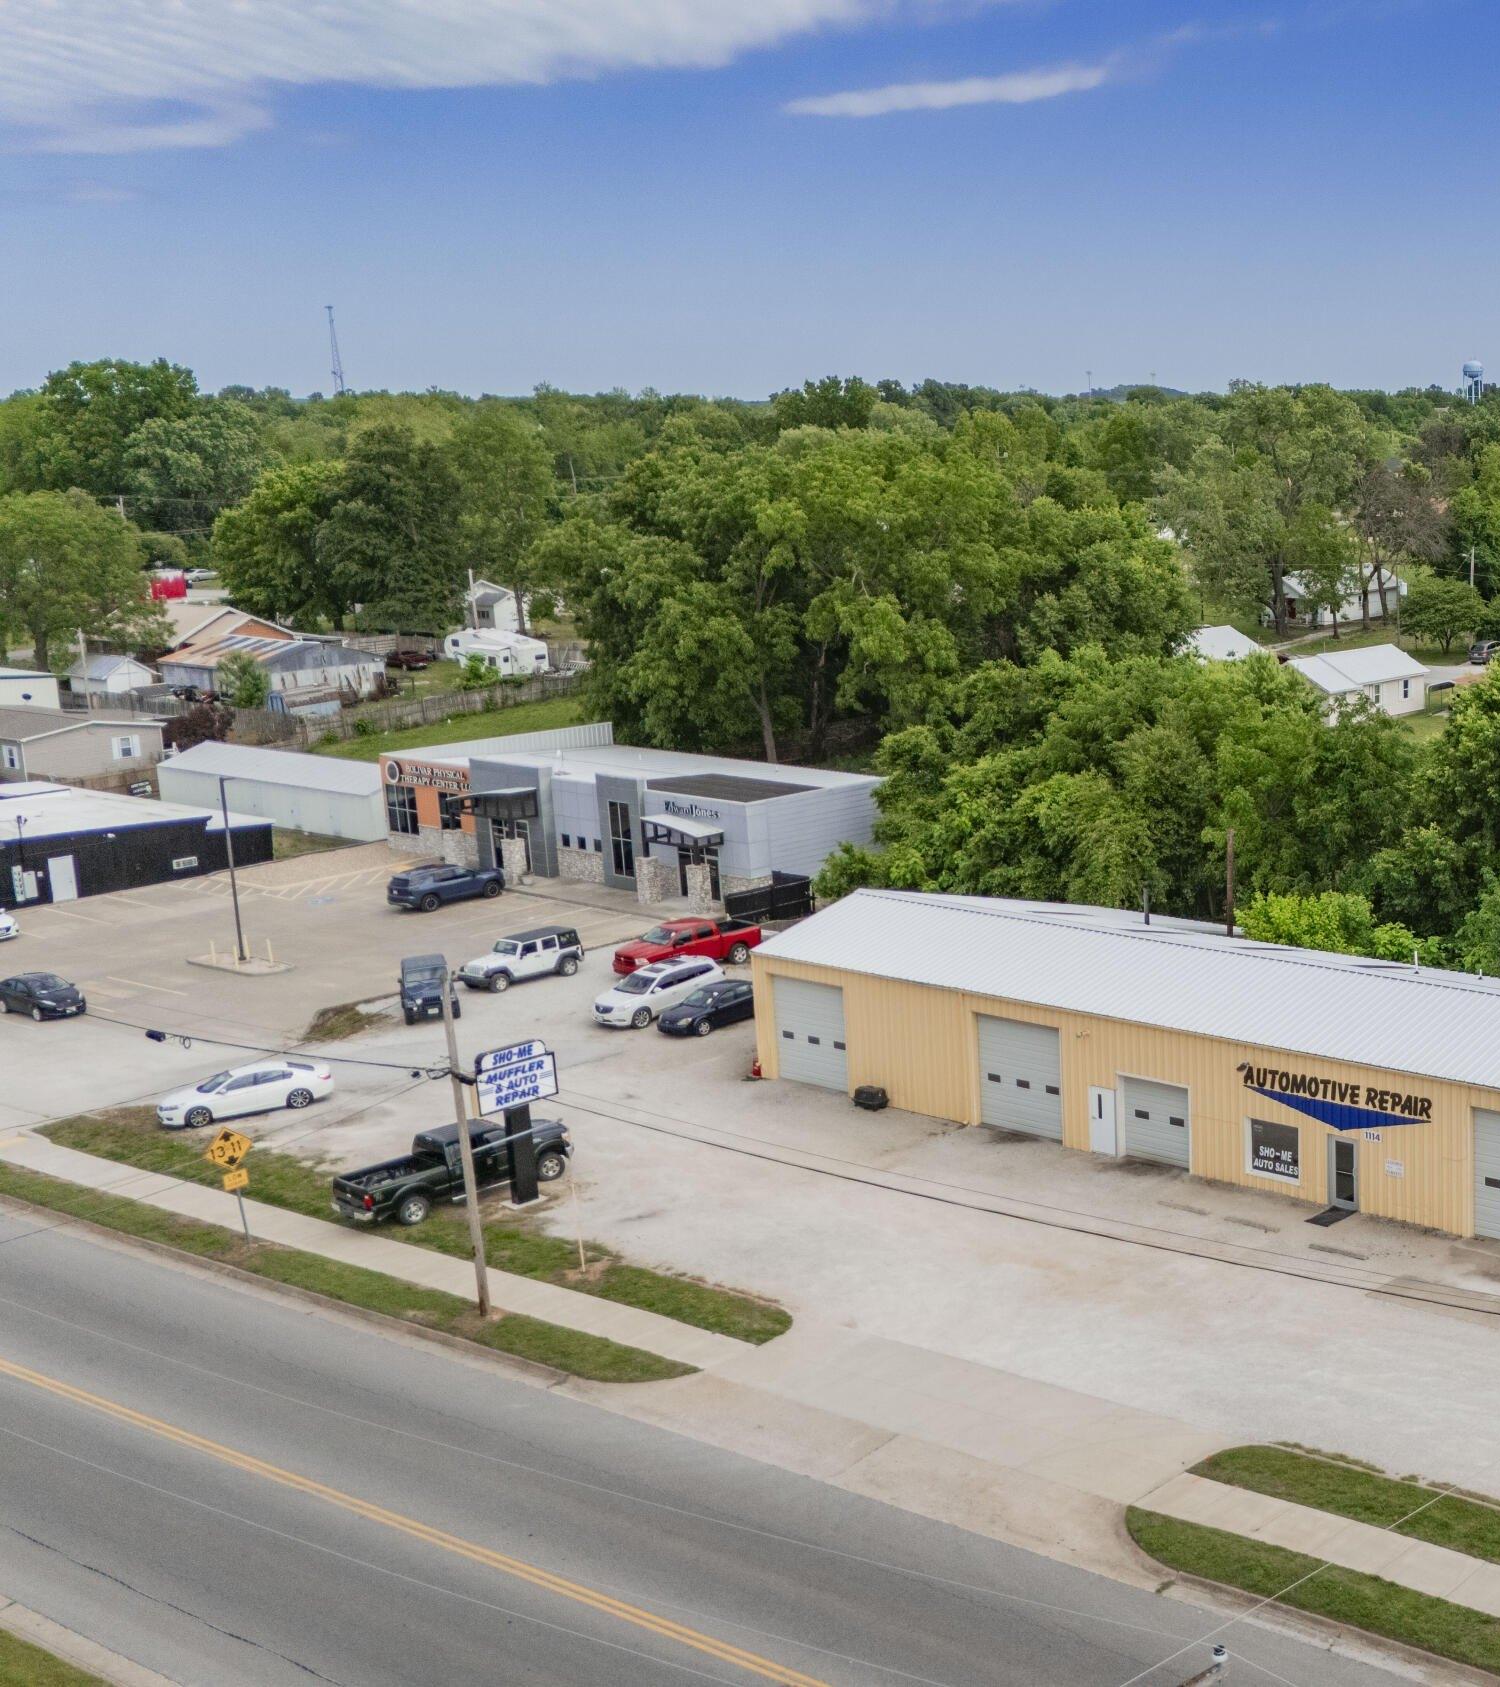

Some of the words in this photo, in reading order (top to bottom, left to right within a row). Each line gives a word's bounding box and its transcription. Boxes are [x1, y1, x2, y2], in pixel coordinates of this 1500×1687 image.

[400, 774, 431, 787] THERAPY
[405, 764, 432, 776] BOLIVAR
[433, 768, 465, 780] PHYSICAL
[692, 804, 720, 819] Jones
[492, 1044, 533, 1066] SHO-ME
[486, 1060, 544, 1084] MUFFLER
[495, 1084, 503, 1094] &
[507, 1073, 538, 1091] AUTO
[1243, 1065, 1361, 1105] AUTOMOTIVE
[1365, 1087, 1433, 1119] REPAIR
[496, 1085, 540, 1107] REPAIR
[1365, 1131, 1381, 1142] 1114
[1259, 1145, 1293, 1162] SHO-ME
[1253, 1158, 1274, 1170] AUTO
[1275, 1162, 1299, 1176] SALES
